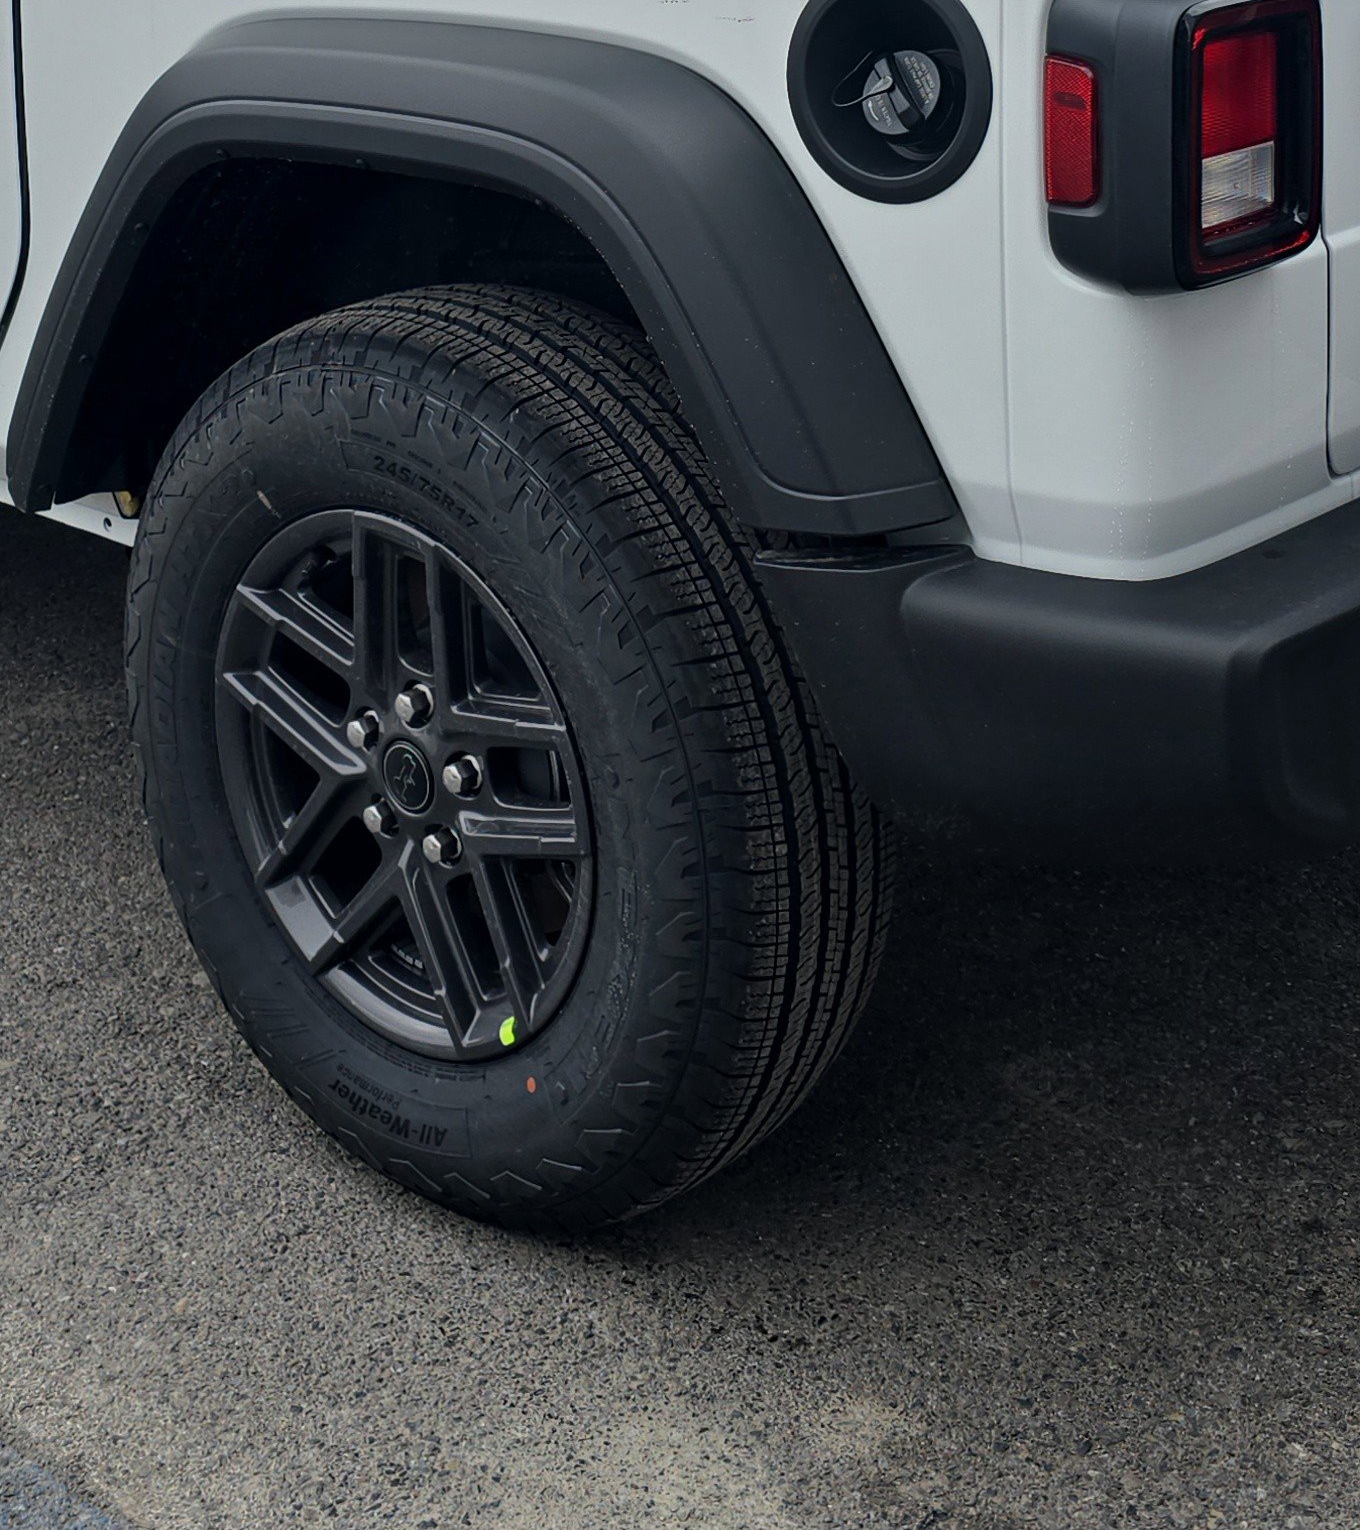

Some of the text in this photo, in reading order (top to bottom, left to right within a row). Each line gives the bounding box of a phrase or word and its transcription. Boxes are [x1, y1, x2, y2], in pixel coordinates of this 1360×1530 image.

[373, 455, 479, 528] 245/75R17
[328, 1079, 448, 1147] All-Weather
[336, 1062, 402, 1110] Performance
